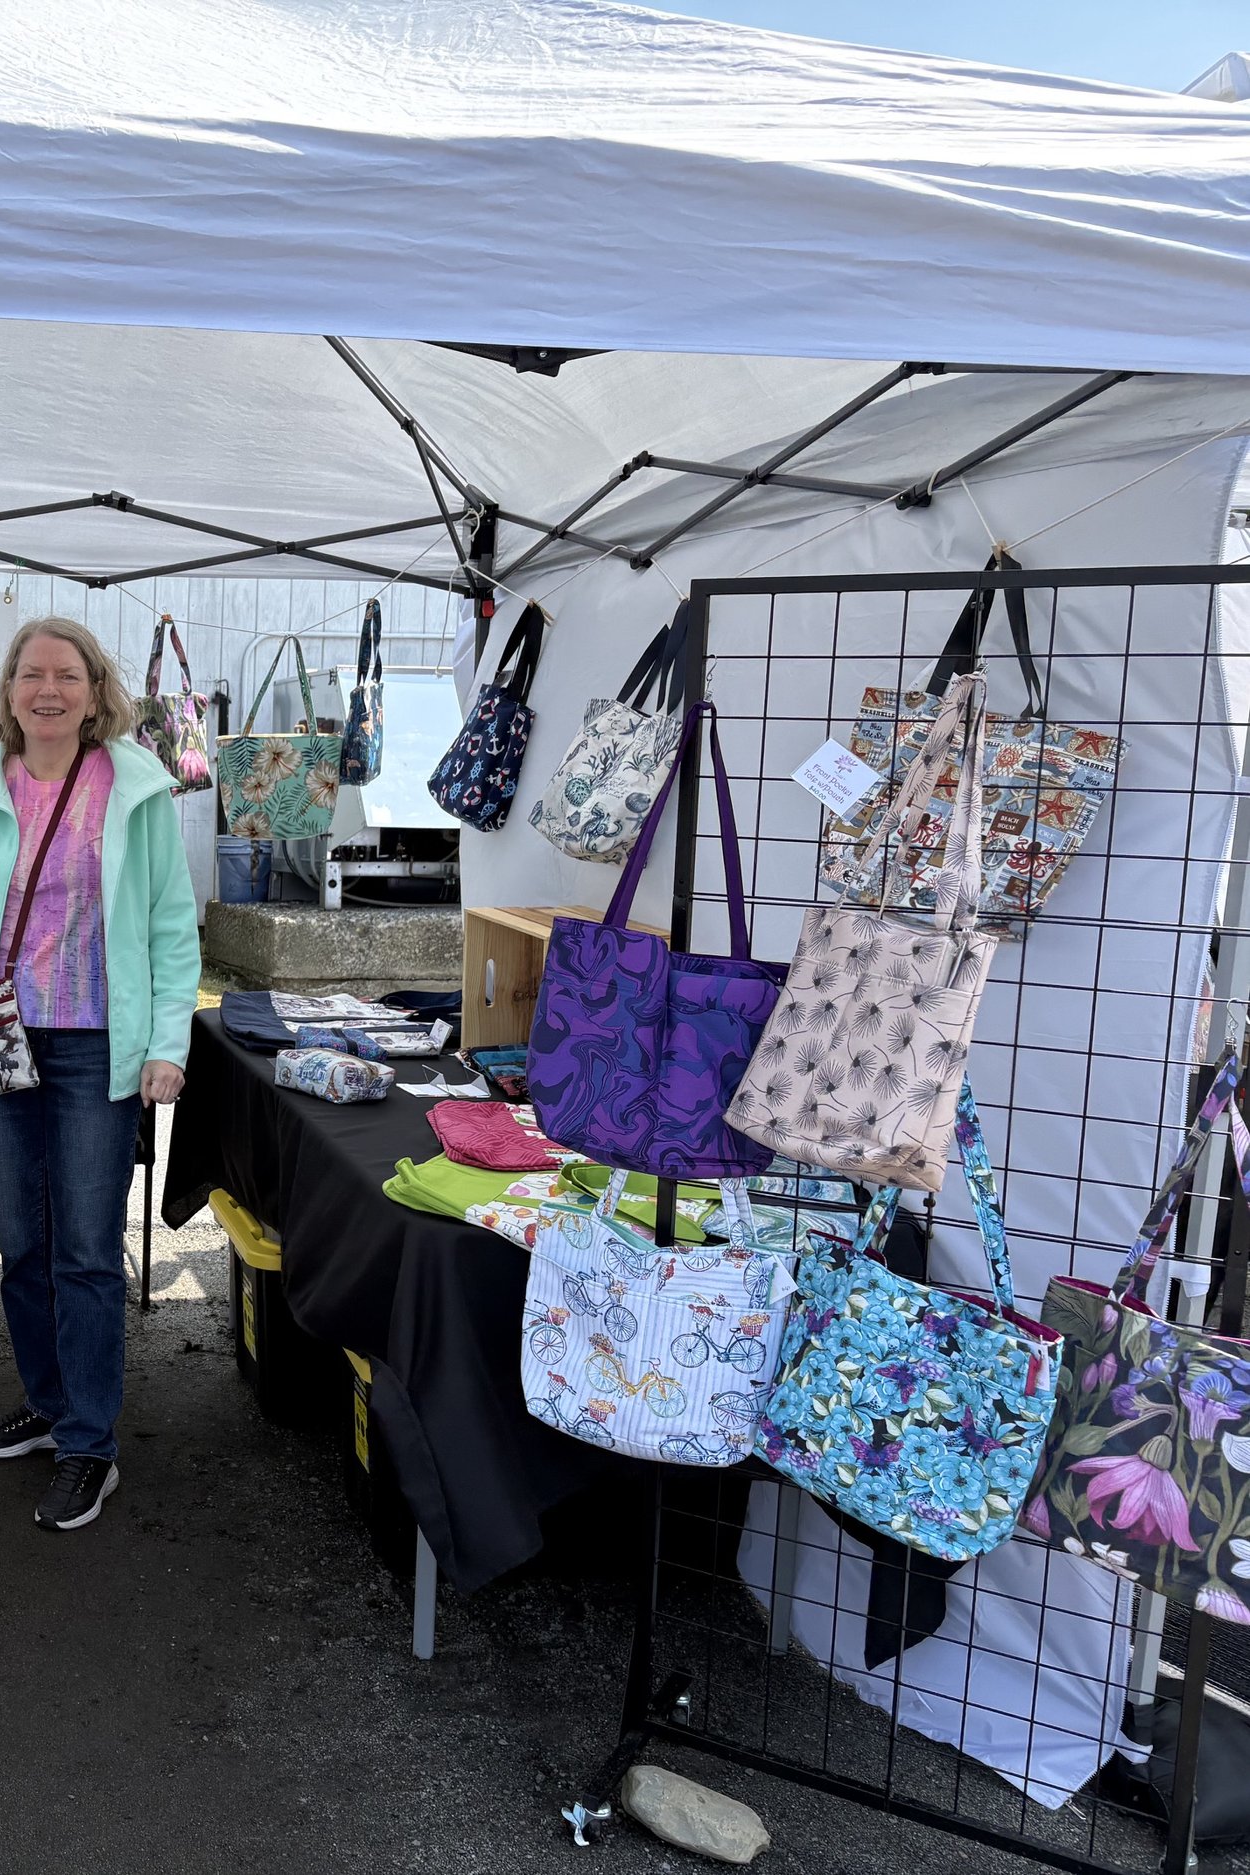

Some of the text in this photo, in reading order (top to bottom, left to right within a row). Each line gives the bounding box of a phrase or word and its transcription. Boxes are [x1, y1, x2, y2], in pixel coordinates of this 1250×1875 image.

[803, 768, 819, 784] Tote
[812, 763, 831, 781] Front
[808, 785, 827, 801] $40.00
[1000, 815, 1019, 825] BEACH
